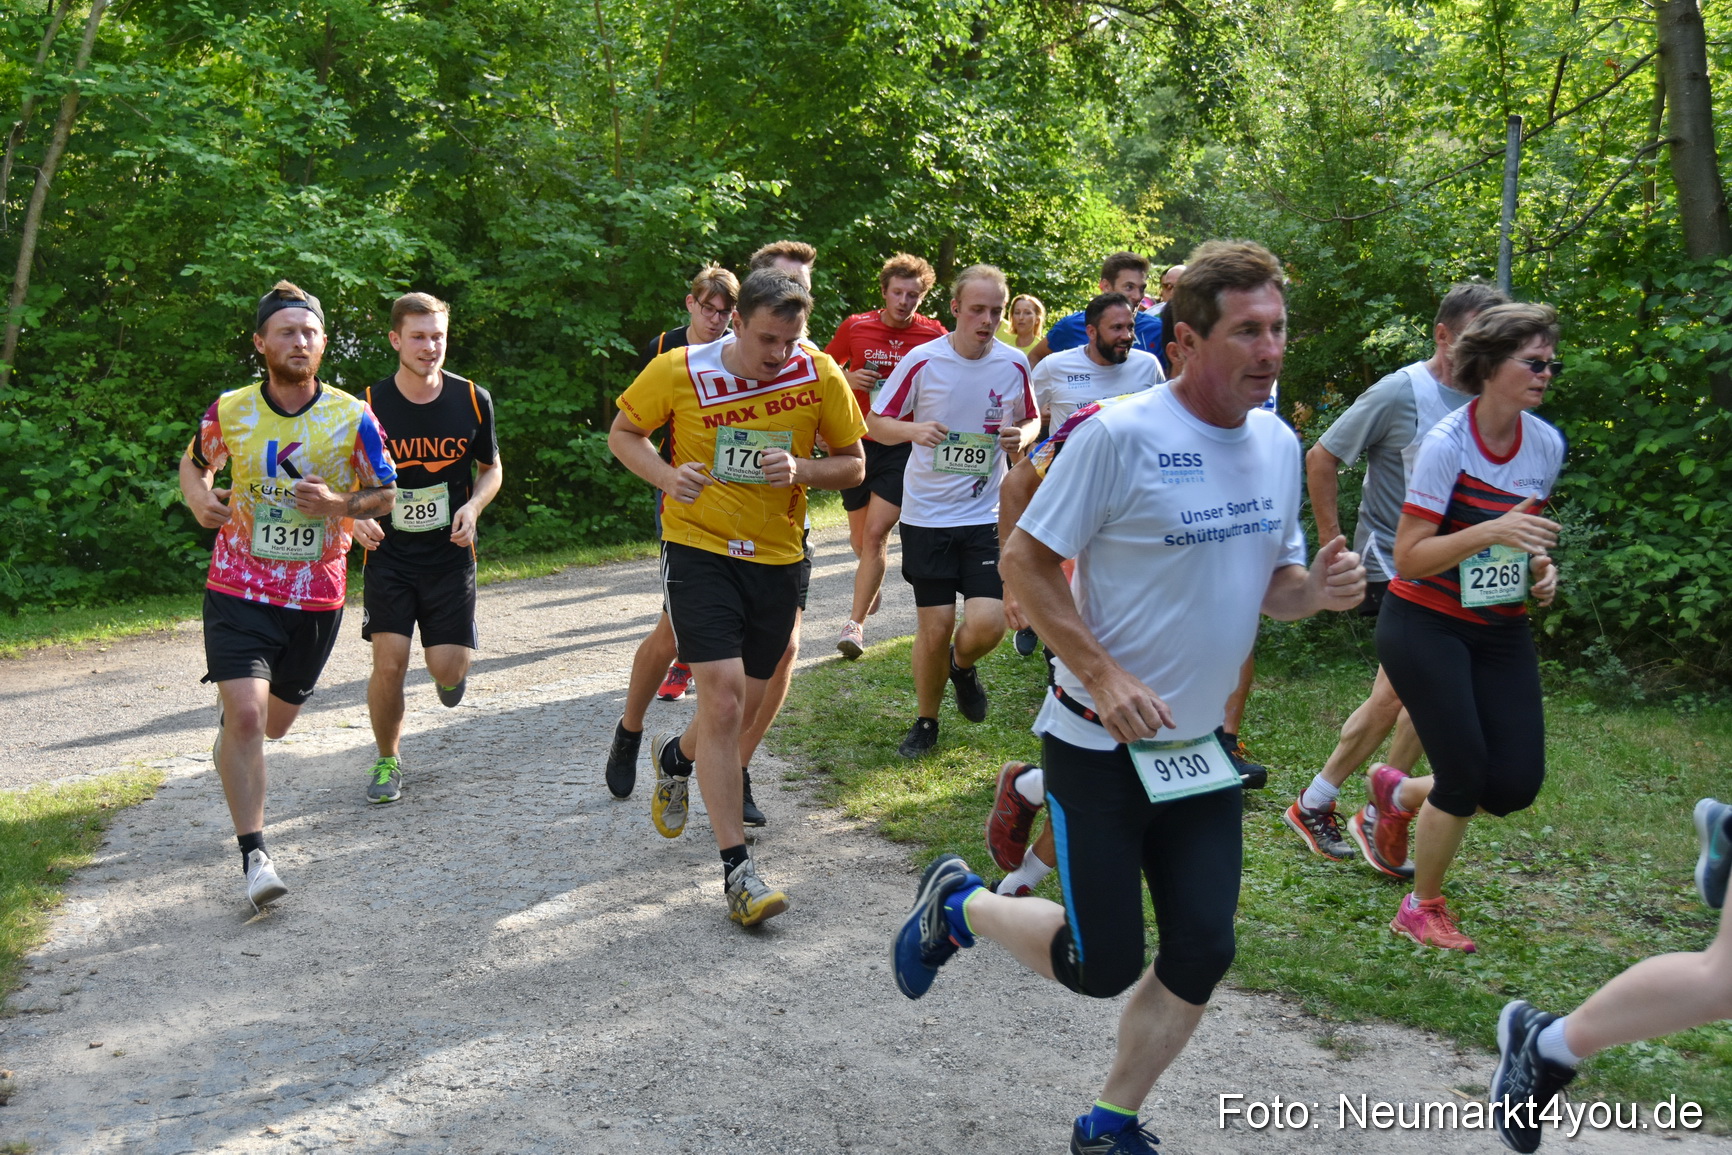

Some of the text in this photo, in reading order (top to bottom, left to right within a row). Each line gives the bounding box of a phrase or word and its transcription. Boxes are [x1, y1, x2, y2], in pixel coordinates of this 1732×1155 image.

[1067, 373, 1091, 383] DESS
[702, 389, 823, 430] MAX BÖGL
[390, 437, 468, 459] WINGS
[725, 447, 766, 470] 170
[942, 446, 986, 465] 1789
[266, 440, 304, 480] K
[1158, 452, 1203, 468] DESS
[1161, 469, 1205, 477] Transporte
[1161, 476, 1206, 485] Logistik
[250, 483, 297, 497] KÜFN
[403, 502, 437, 520] 289
[1181, 496, 1274, 525] Unser Sport ist
[262, 524, 315, 547] 1319
[1470, 563, 1520, 590] 2268
[1154, 753, 1210, 782] 9130
